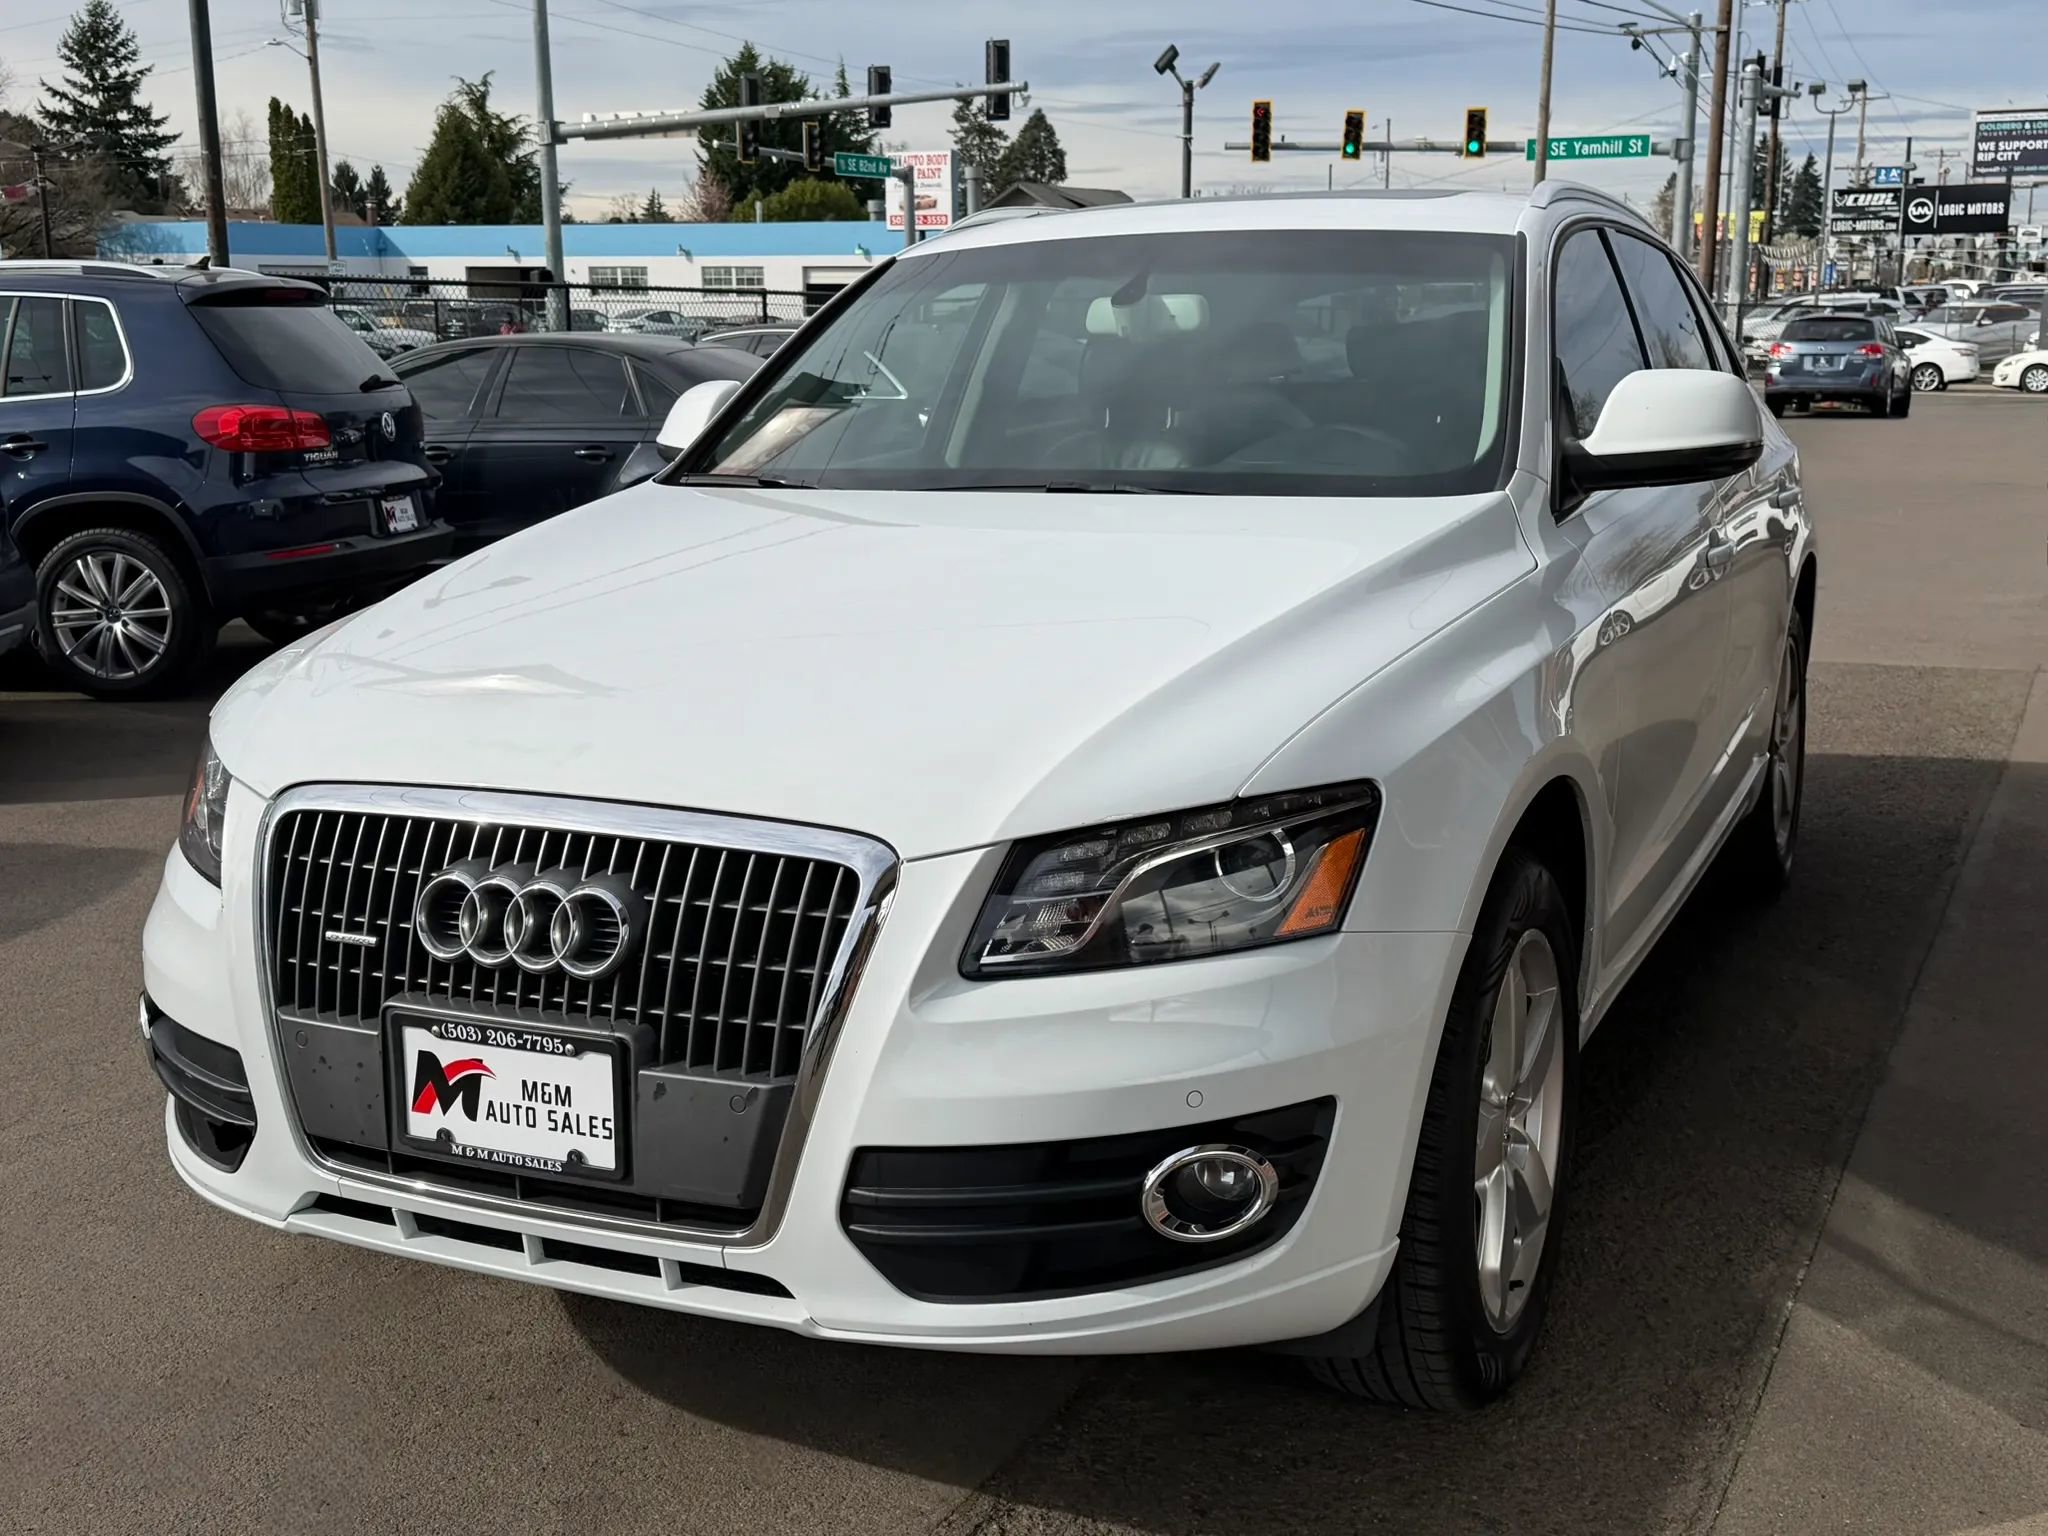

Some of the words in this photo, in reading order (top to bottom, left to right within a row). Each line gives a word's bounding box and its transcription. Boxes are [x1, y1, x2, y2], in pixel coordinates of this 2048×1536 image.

[1550, 141, 1567, 156] SE
[1573, 140, 1622, 155] Yamhill
[1628, 139, 1643, 153] St
[1978, 142, 1996, 151] WE
[1998, 140, 2048, 150] SUPPORT
[903, 154, 924, 166] AUTO
[927, 154, 948, 165] BODY
[1977, 152, 1995, 161] RIP
[1997, 151, 2020, 160] CITY
[847, 158, 857, 171] SE
[878, 161, 888, 173] Av
[917, 168, 941, 179] PAINT
[1939, 203, 1965, 216] LOGIC
[1967, 202, 2005, 215] MOTORS
[304, 451, 338, 461] TIGUAN
[440, 1022, 482, 1042] (503)
[486, 1028, 564, 1054] 206-7795
[521, 1079, 572, 1108] M&M
[485, 1100, 537, 1129] AUTO
[548, 1109, 613, 1140] SALES
[451, 1144, 464, 1157] M
[466, 1147, 475, 1157] &
[477, 1149, 489, 1161] M
[491, 1152, 523, 1166] AUTO
[524, 1157, 563, 1173] SALES
